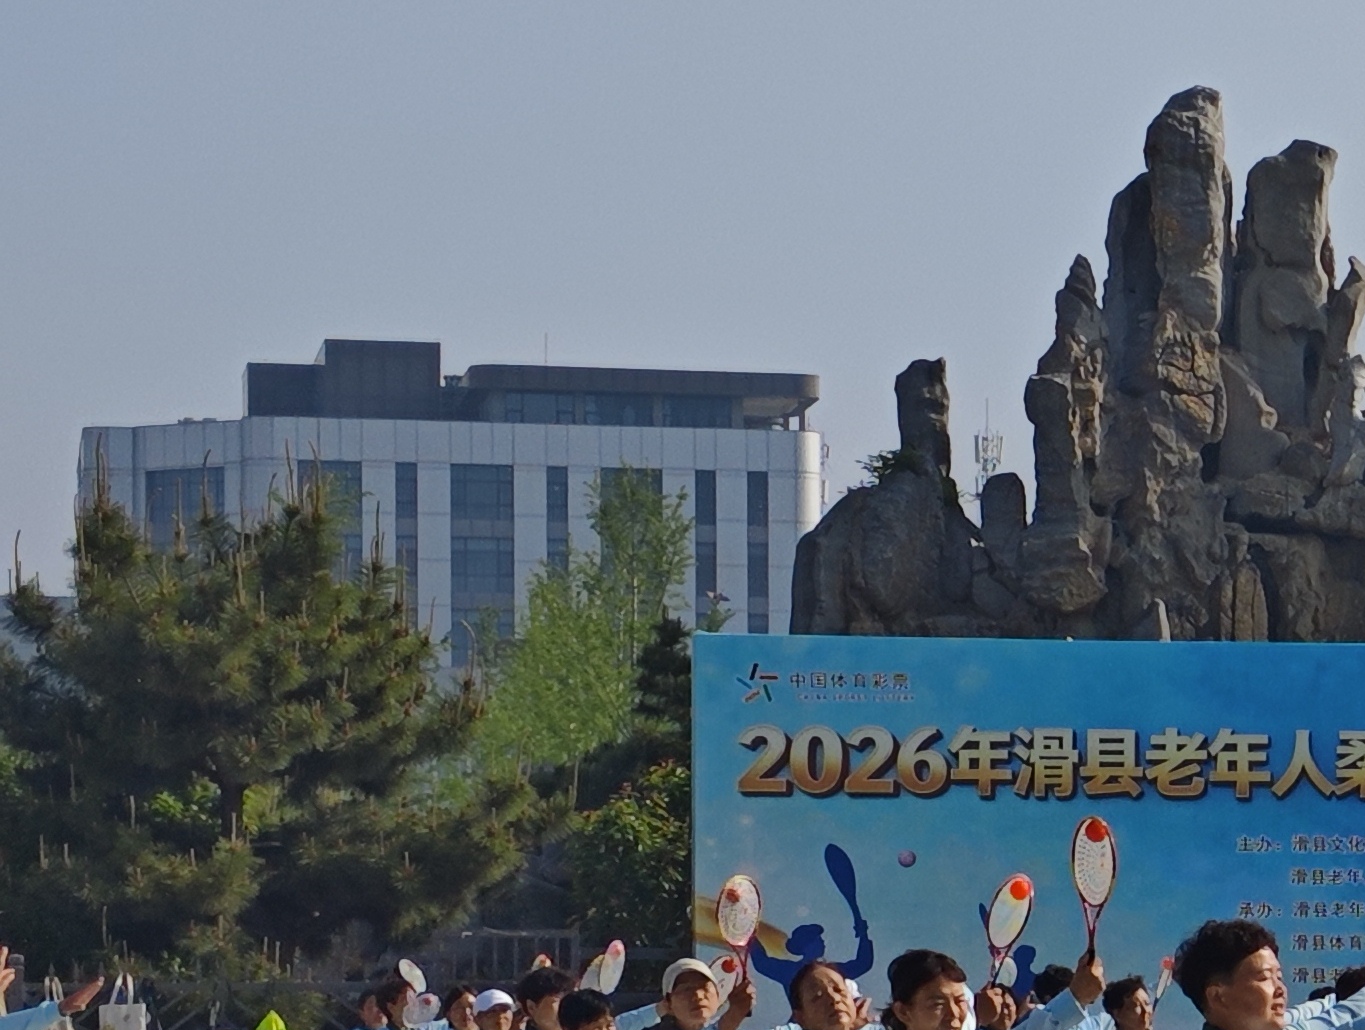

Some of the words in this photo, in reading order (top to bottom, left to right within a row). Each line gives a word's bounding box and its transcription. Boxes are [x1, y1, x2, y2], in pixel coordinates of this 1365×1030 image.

[789, 671, 909, 690] 中国体育彩票
